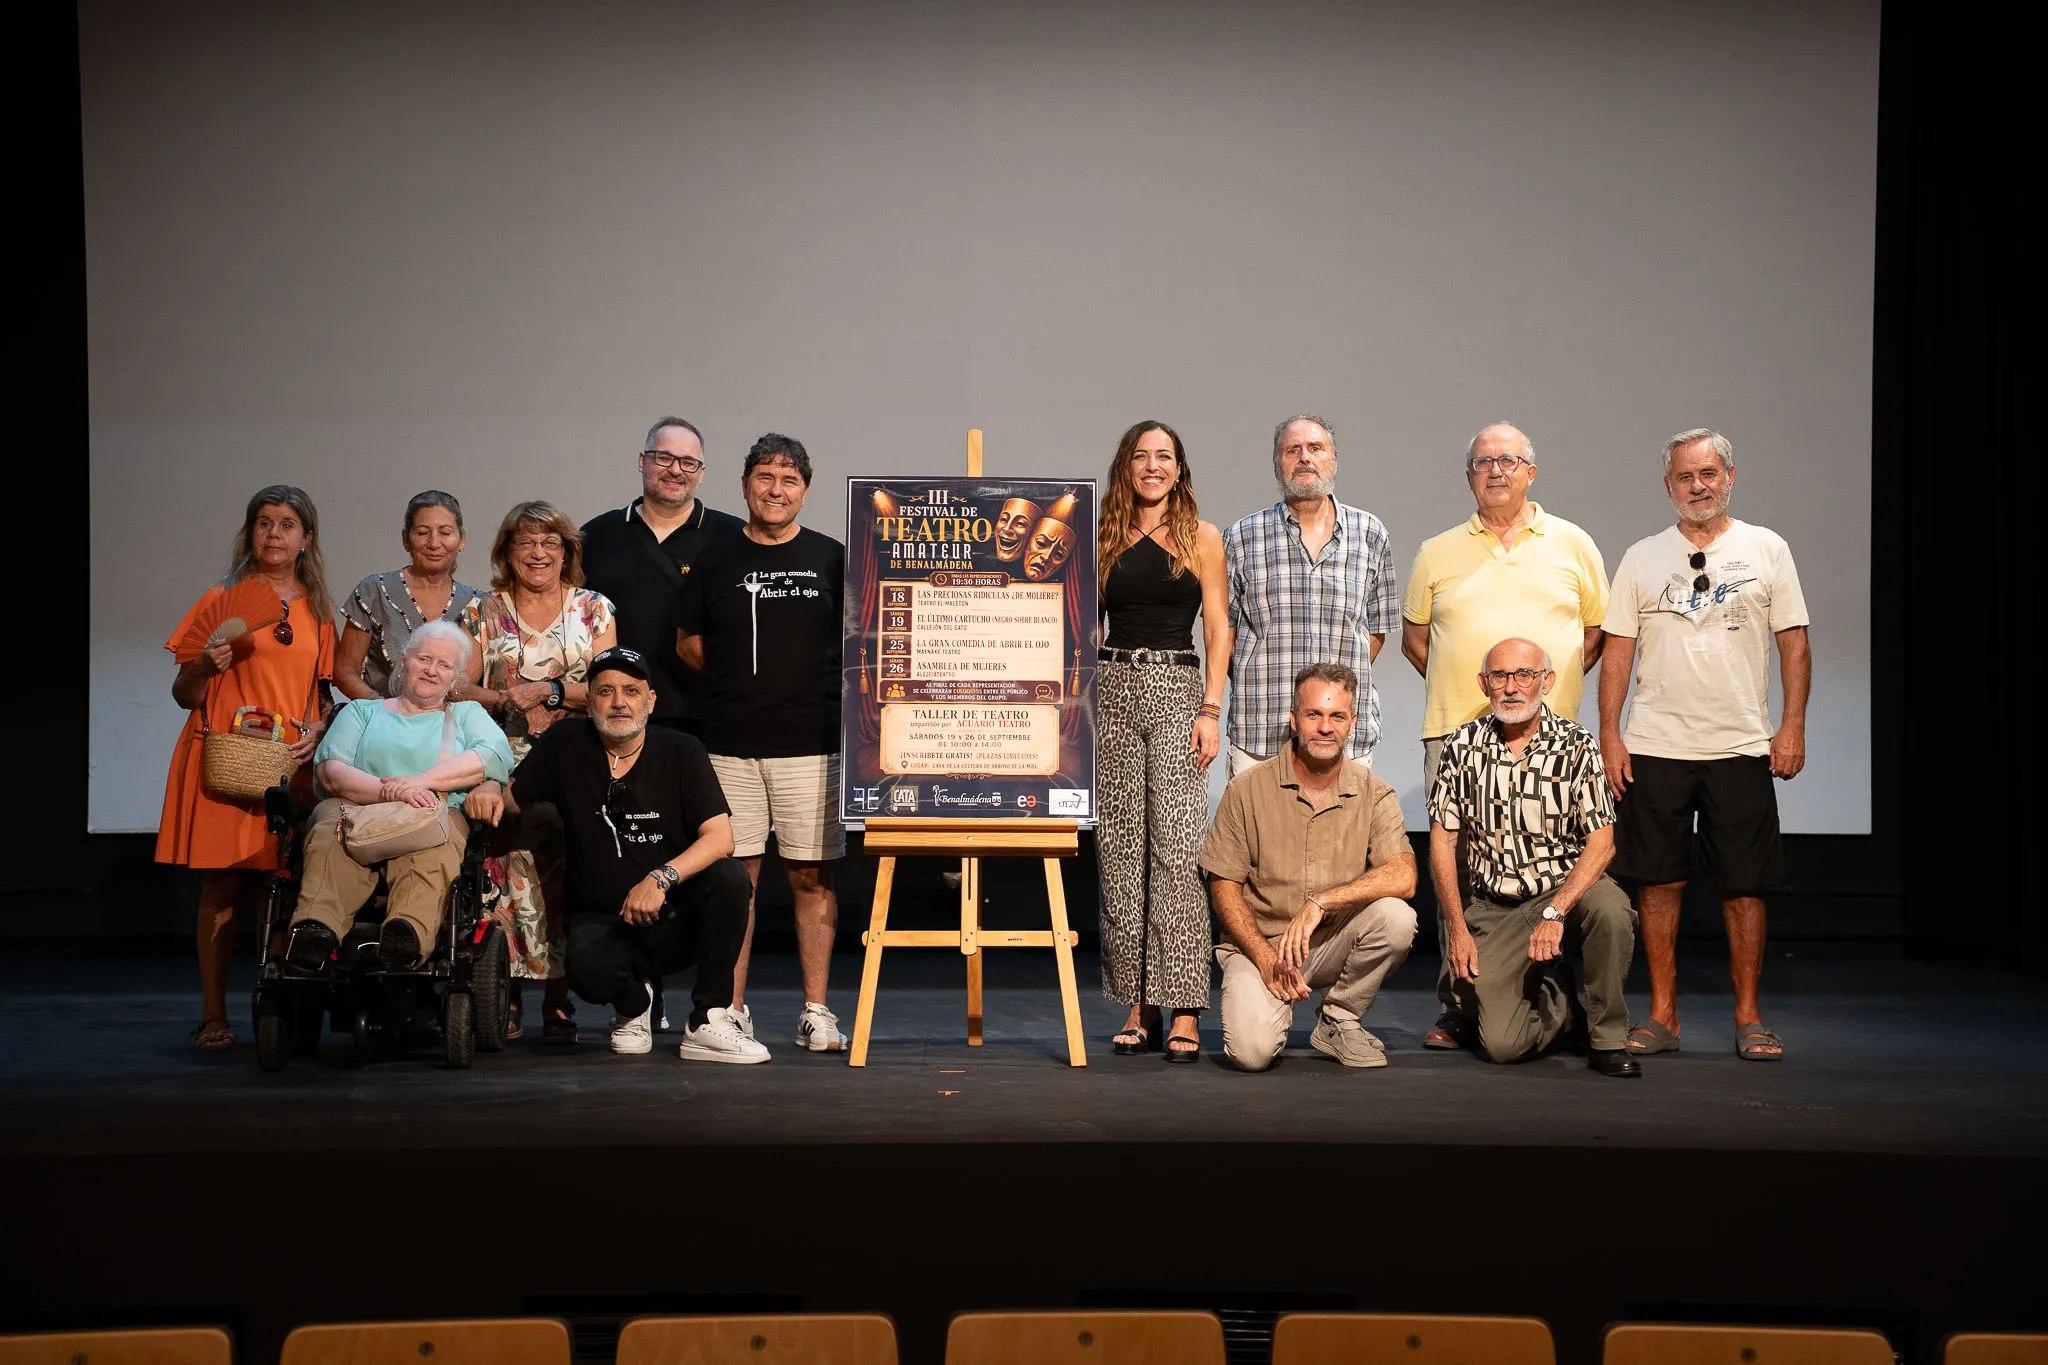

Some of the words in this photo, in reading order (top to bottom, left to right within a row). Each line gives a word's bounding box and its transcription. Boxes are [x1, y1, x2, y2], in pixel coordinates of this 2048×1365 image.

[928, 490, 948, 505] III
[899, 506, 957, 517] FESTIVAL
[961, 507, 978, 517] DE
[876, 517, 992, 542] TEATRO
[892, 543, 972, 560] AMATEUR
[890, 561, 902, 569] DE
[906, 560, 973, 570] BENALMÁDENA
[759, 571, 769, 579] La
[770, 571, 787, 580] gran
[787, 570, 818, 578] comedia
[759, 587, 788, 598] Abrir
[790, 586, 800, 596] el
[802, 588, 819, 598] ojo
[917, 590, 931, 599] LAS
[933, 590, 972, 599] PRECIOSAS
[891, 592, 905, 603] 18
[891, 616, 905, 627] 19
[917, 614, 925, 623] EL
[927, 612, 953, 623] ÚLTIMO
[954, 614, 991, 623] CARTUCHO
[1014, 616, 1032, 624] SOBRE
[890, 640, 904, 650] 25
[917, 639, 927, 647] LA
[929, 639, 950, 647] GRAN
[951, 639, 985, 648] COMEDIA
[987, 640, 997, 648] DE
[1000, 640, 1022, 648] ABRIR
[1024, 640, 1034, 648] EL
[1035, 640, 1050, 649] OJO
[889, 663, 904, 673] 26
[916, 662, 958, 670] ASAMBLEA
[961, 662, 970, 670] DE
[973, 662, 1007, 671] MUJERES
[912, 709, 958, 719] TALLER
[963, 710, 978, 719] DE
[982, 710, 1029, 720] TEATRO
[956, 719, 995, 727] ACUARIO
[998, 720, 1031, 728] TEATRO
[909, 732, 944, 740] SÁBADOS
[893, 789, 915, 803] CATA
[939, 793, 992, 803] Benalmádena
[633, 811, 660, 819] comedia
[630, 822, 639, 831] de
[637, 832, 647, 843] el
[648, 833, 663, 843] ojo
